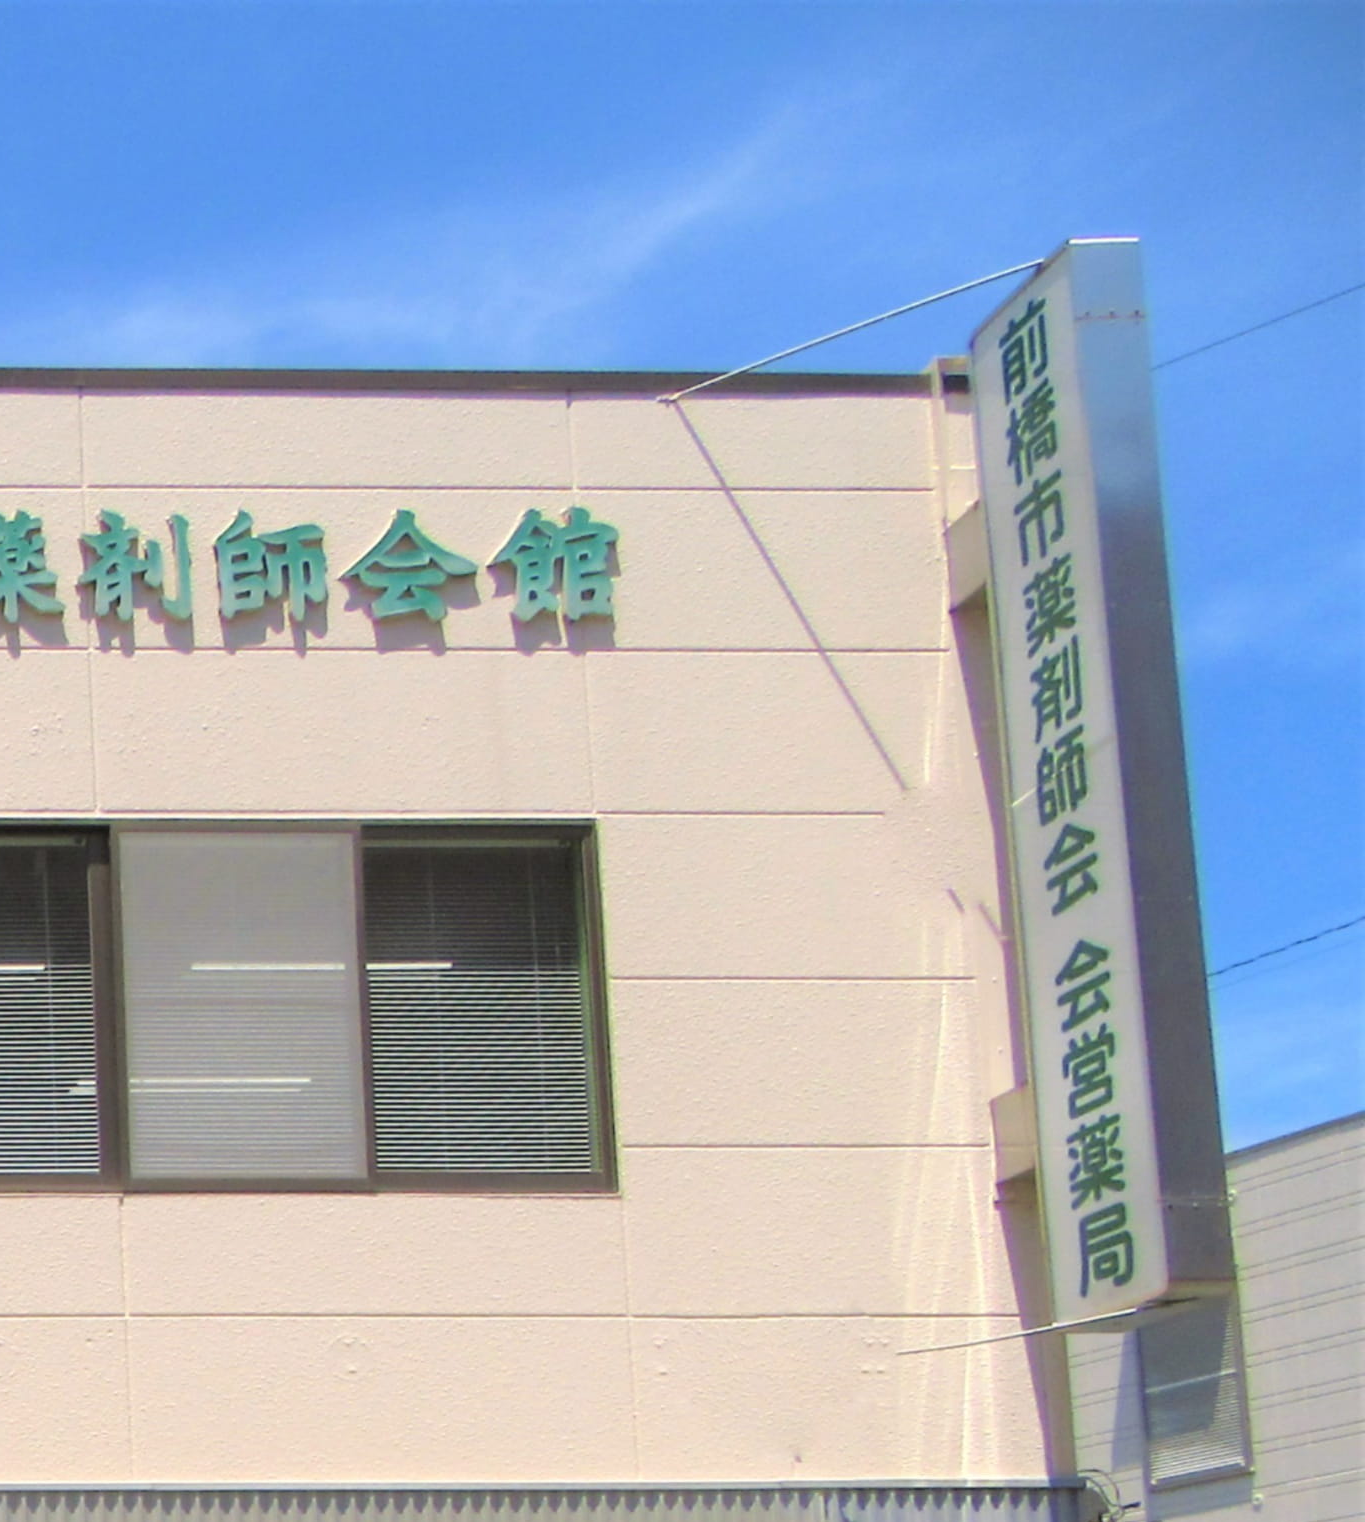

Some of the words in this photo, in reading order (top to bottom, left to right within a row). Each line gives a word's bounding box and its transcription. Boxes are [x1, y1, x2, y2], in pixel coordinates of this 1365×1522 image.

[1000, 298, 1099, 916] 前橋市薬剤師会
[1053, 936, 1135, 1300] 会営薬局
